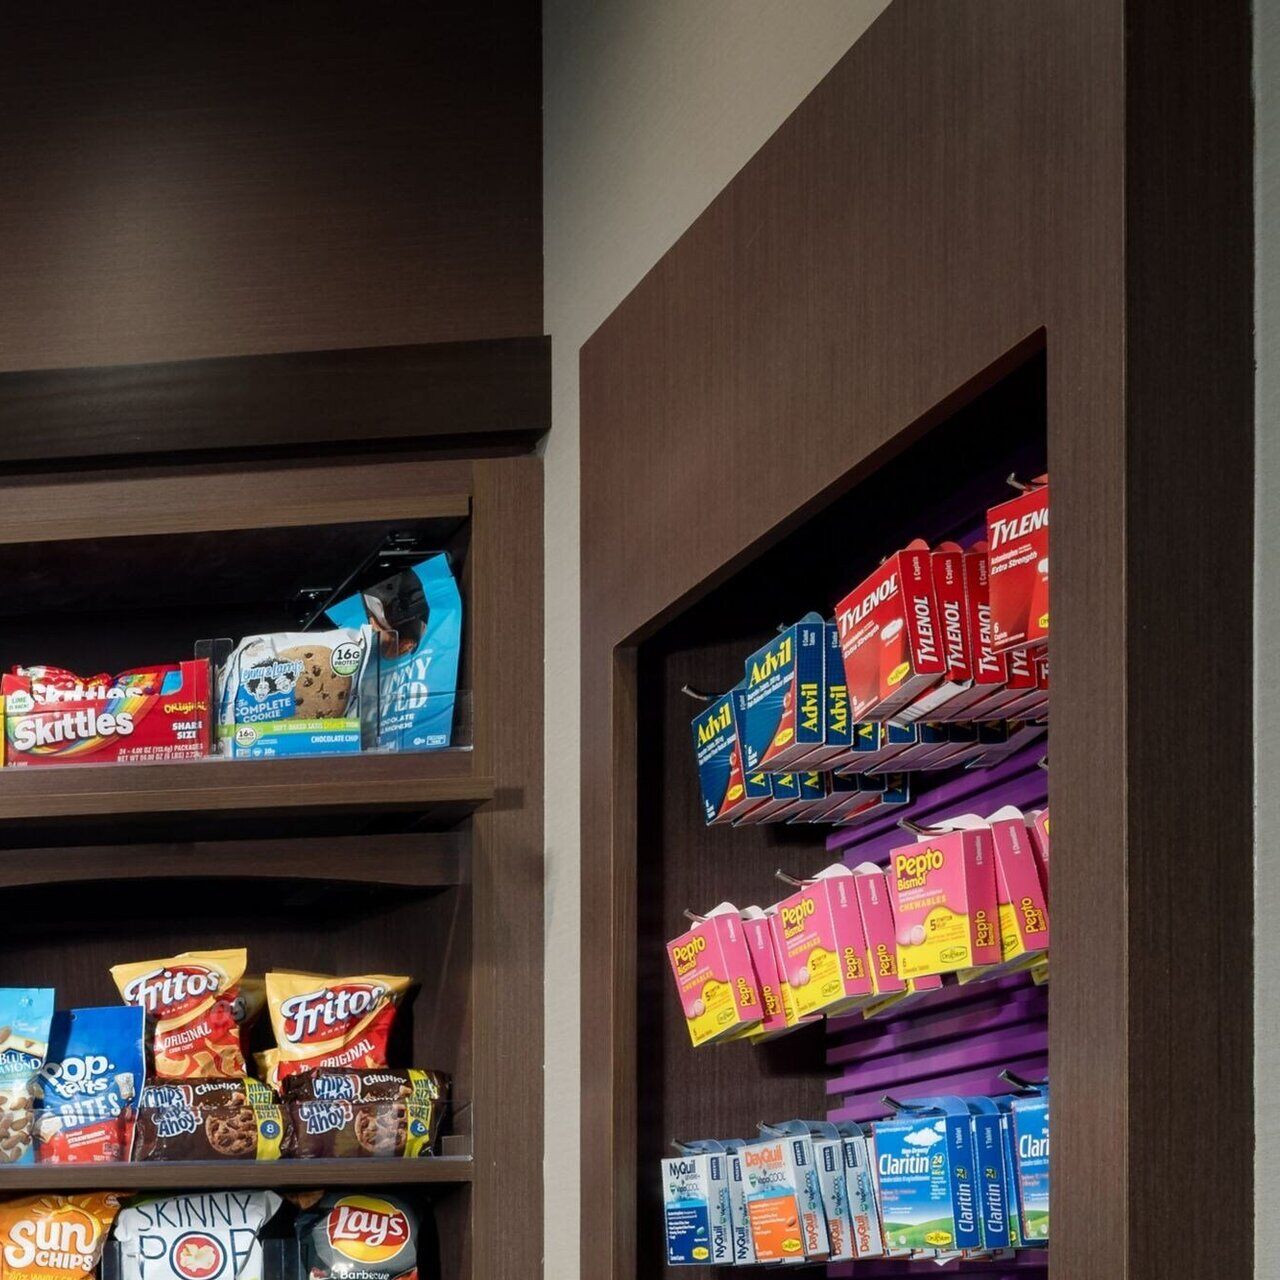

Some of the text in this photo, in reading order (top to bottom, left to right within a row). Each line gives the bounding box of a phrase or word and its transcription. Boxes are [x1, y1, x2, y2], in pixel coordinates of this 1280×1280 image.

[992, 552, 1038, 575] Extra Strength
[840, 573, 897, 638] TYLENOL
[914, 596, 939, 664] TYLENOL
[945, 601, 966, 672] TYLENOL
[748, 637, 792, 688] Advil
[243, 710, 281, 722] COOKIE
[800, 682, 818, 731] Advil
[14, 712, 133, 752] Skittles
[173, 721, 202, 730] SHARE
[311, 736, 344, 744] CHOCOLATE
[695, 703, 732, 747] Advil
[896, 848, 943, 878] Pepto
[897, 875, 926, 891] Bismol
[782, 898, 815, 928] Pepto
[673, 935, 705, 963] Pepto
[124, 969, 219, 1013] Fritos
[281, 986, 392, 1044] Fritos
[56, 1077, 108, 1098] tarts
[195, 1083, 241, 1095] CHUNKY
[363, 1074, 408, 1085] CHUNKY
[60, 1093, 121, 1127] BITES
[669, 1160, 696, 1179] NyQuil
[745, 1145, 783, 1166] DayQuil
[879, 1154, 942, 1175] Claritin 24
[136, 1195, 251, 1231] SKINNY
[958, 1184, 974, 1232] Claritin
[988, 1184, 1003, 1233] Claritin
[332, 1206, 405, 1247] Lay's
[714, 1226, 724, 1258] NyQuil
[804, 1212, 818, 1250] DayQuil
[4, 1220, 97, 1268] Sun
[35, 1252, 93, 1271] CHIPS
[340, 1269, 389, 1280] Barbecue
